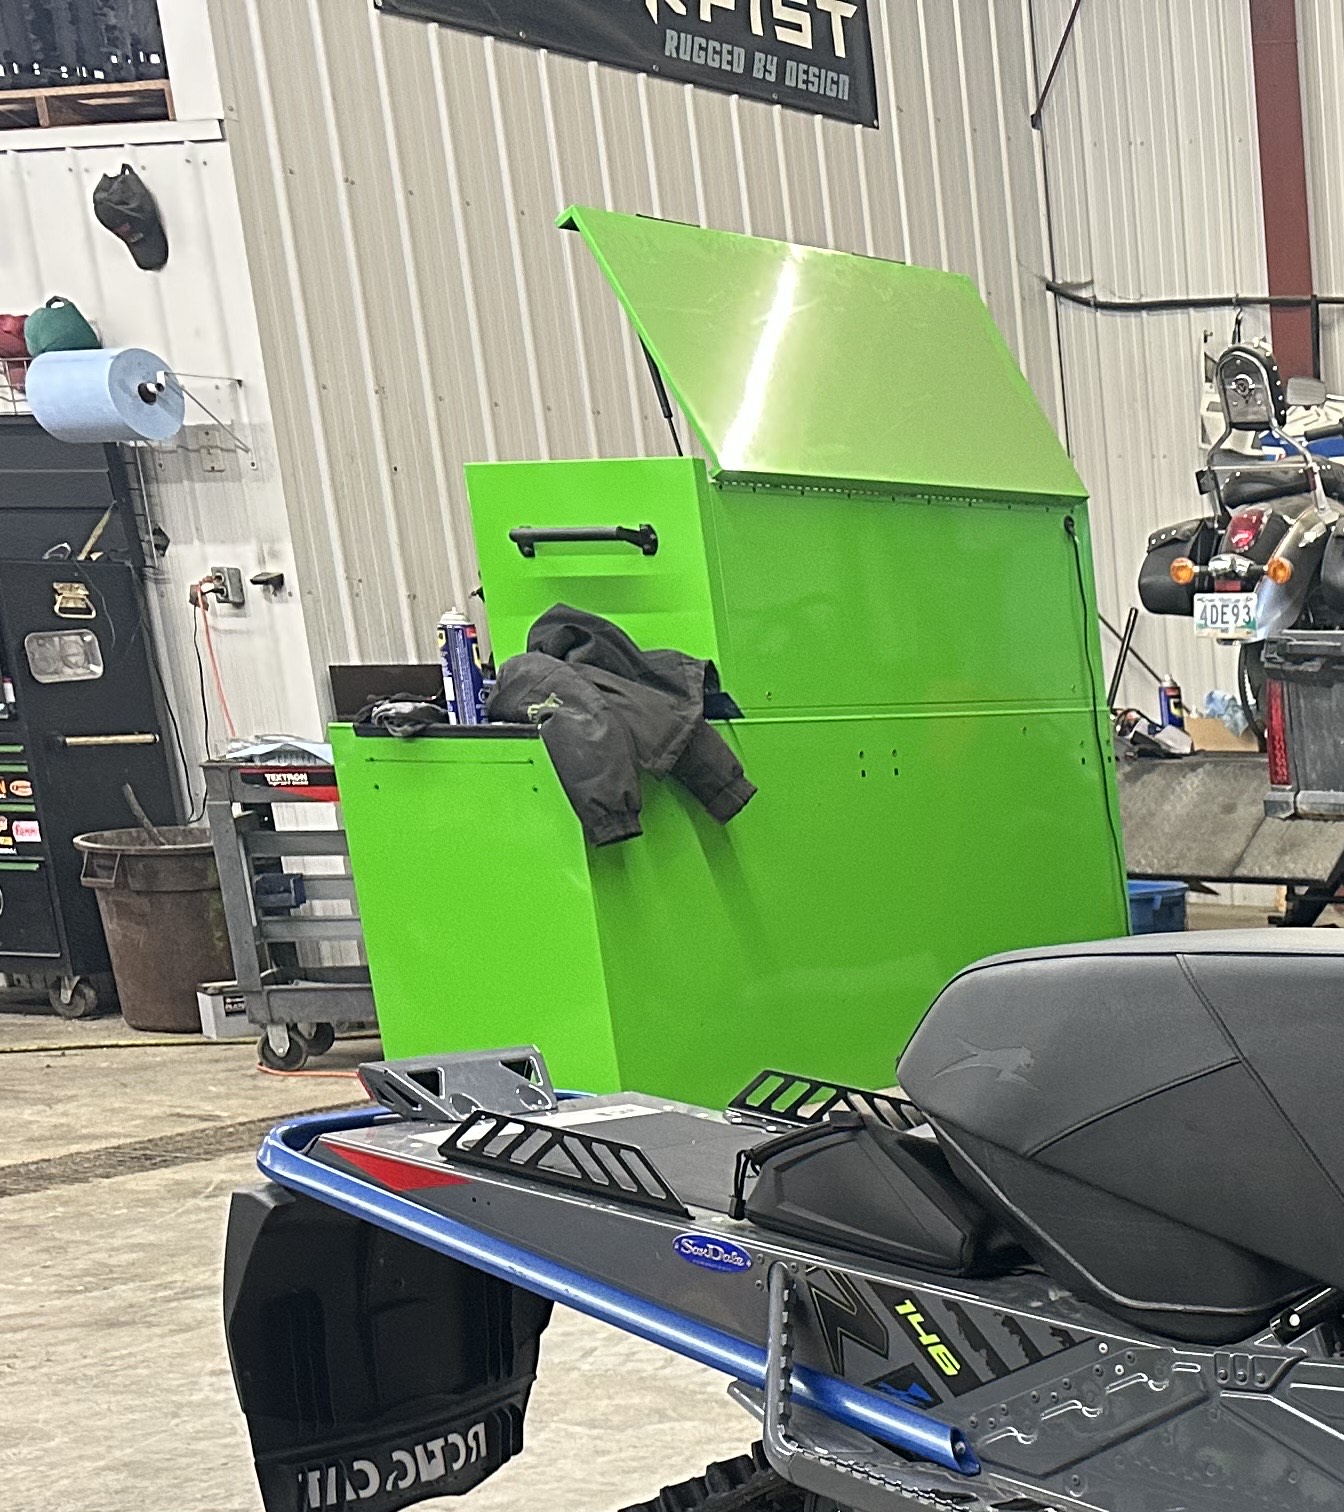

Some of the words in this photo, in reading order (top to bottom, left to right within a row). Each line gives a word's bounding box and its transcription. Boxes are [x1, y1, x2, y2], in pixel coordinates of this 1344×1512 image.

[664, 29, 746, 74] RUGGED
[753, 51, 778, 82] BY
[784, 59, 850, 101] DESIGN
[1200, 604, 1252, 627] 4DE93
[264, 772, 308, 782] TEXTRON
[895, 1299, 961, 1376] 146
